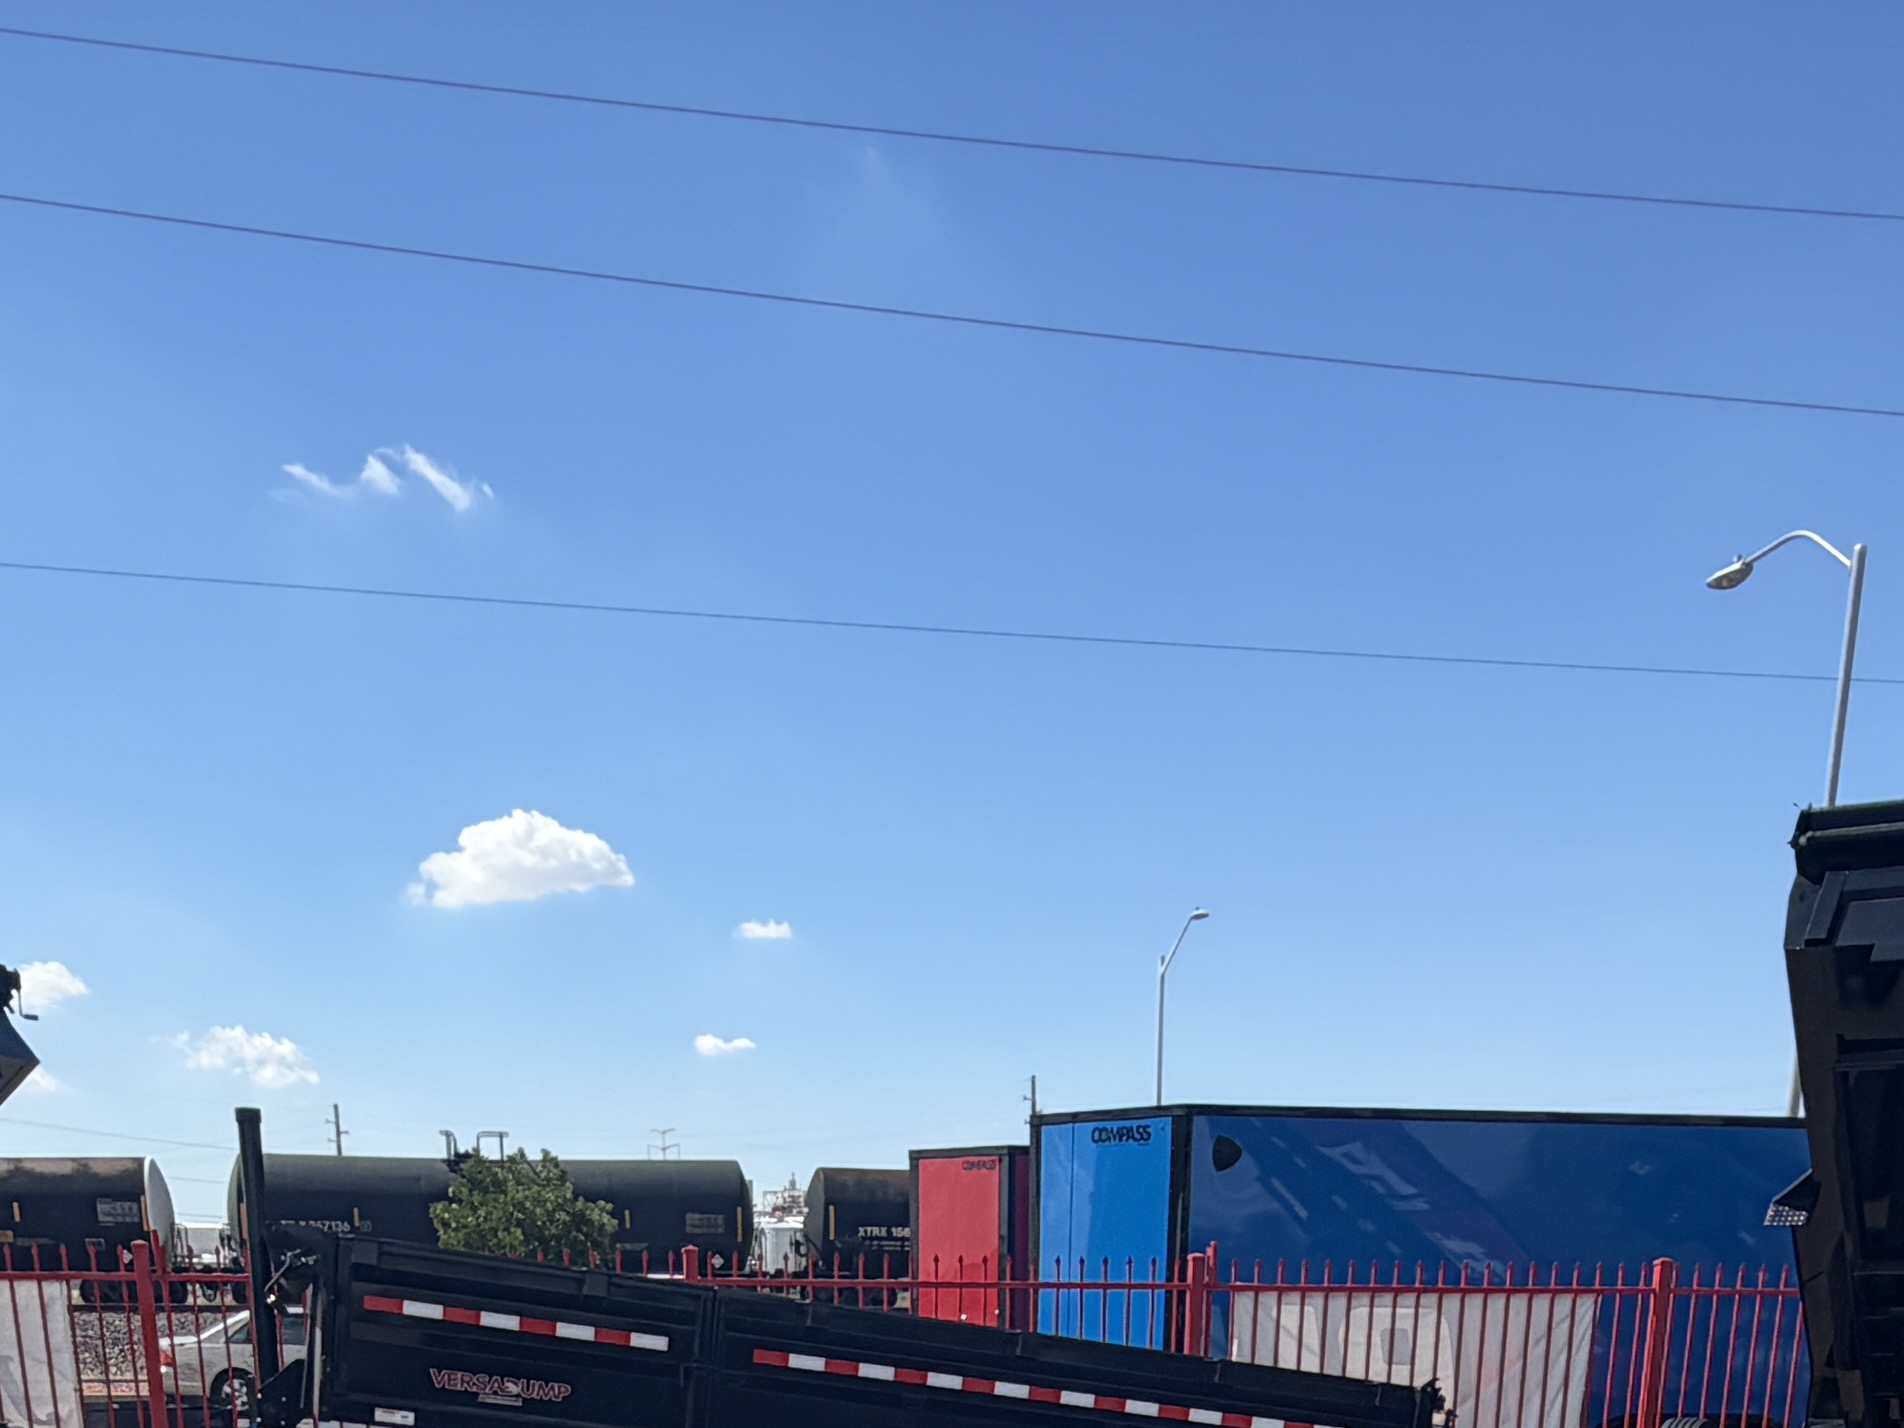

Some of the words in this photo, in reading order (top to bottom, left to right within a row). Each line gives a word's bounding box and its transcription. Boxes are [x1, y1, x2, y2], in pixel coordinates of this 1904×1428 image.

[1091, 1124, 1152, 1144] COMPASS
[858, 1226, 887, 1238] XTRX
[429, 1367, 572, 1402] VERSADUMP
